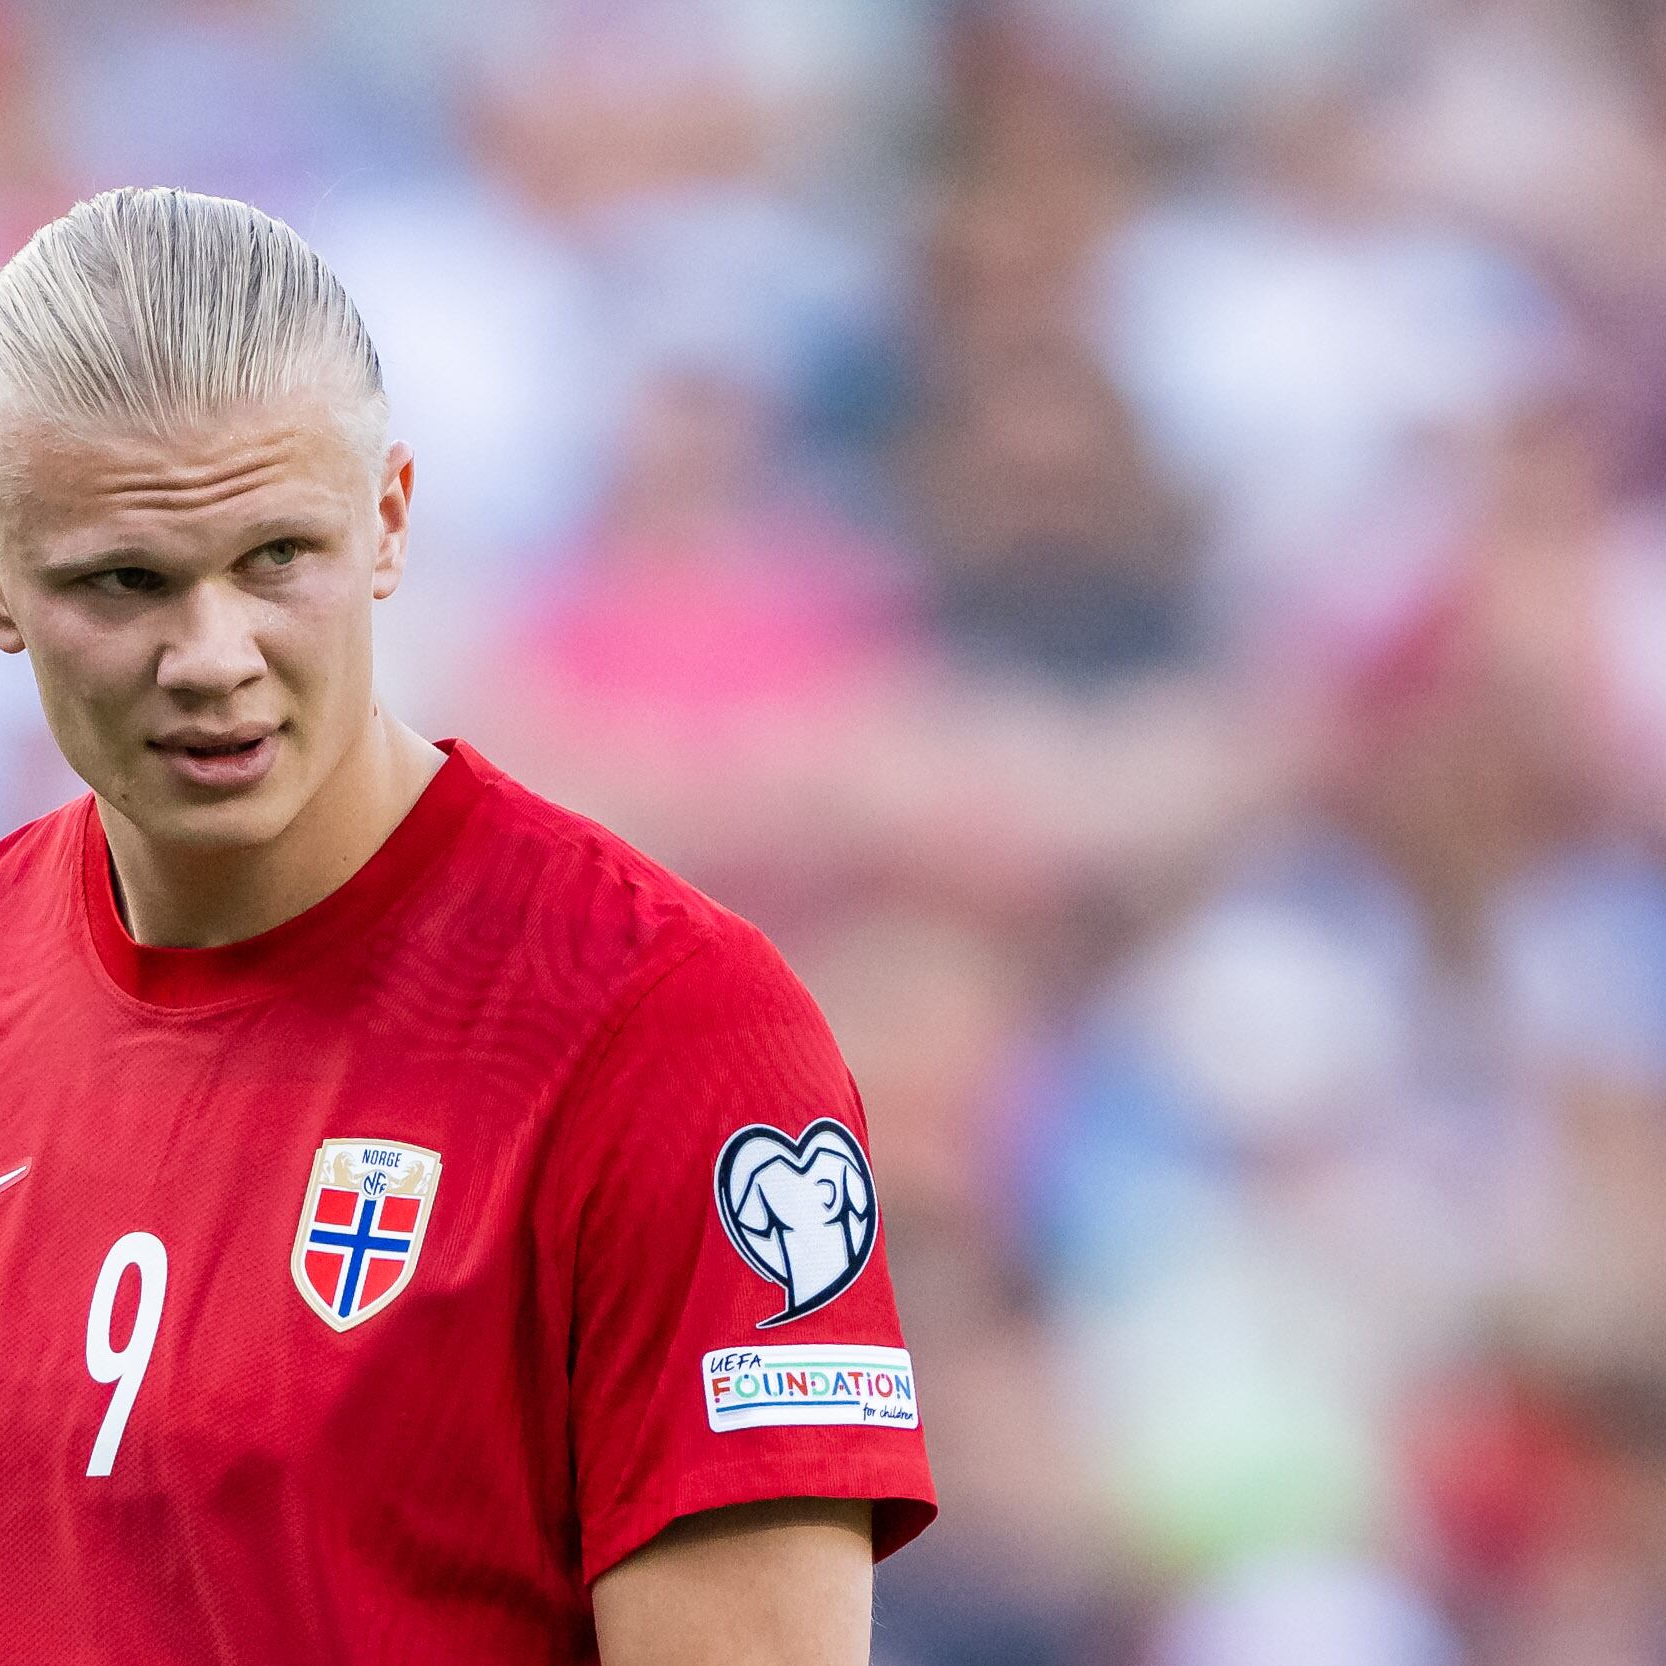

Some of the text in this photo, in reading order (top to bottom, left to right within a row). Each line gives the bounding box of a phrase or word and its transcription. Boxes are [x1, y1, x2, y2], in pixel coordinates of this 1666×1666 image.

[362, 1148, 403, 1168] NORGE
[86, 1231, 168, 1477] 9
[710, 1352, 762, 1374] UEFA
[863, 1403, 914, 1422] for children
